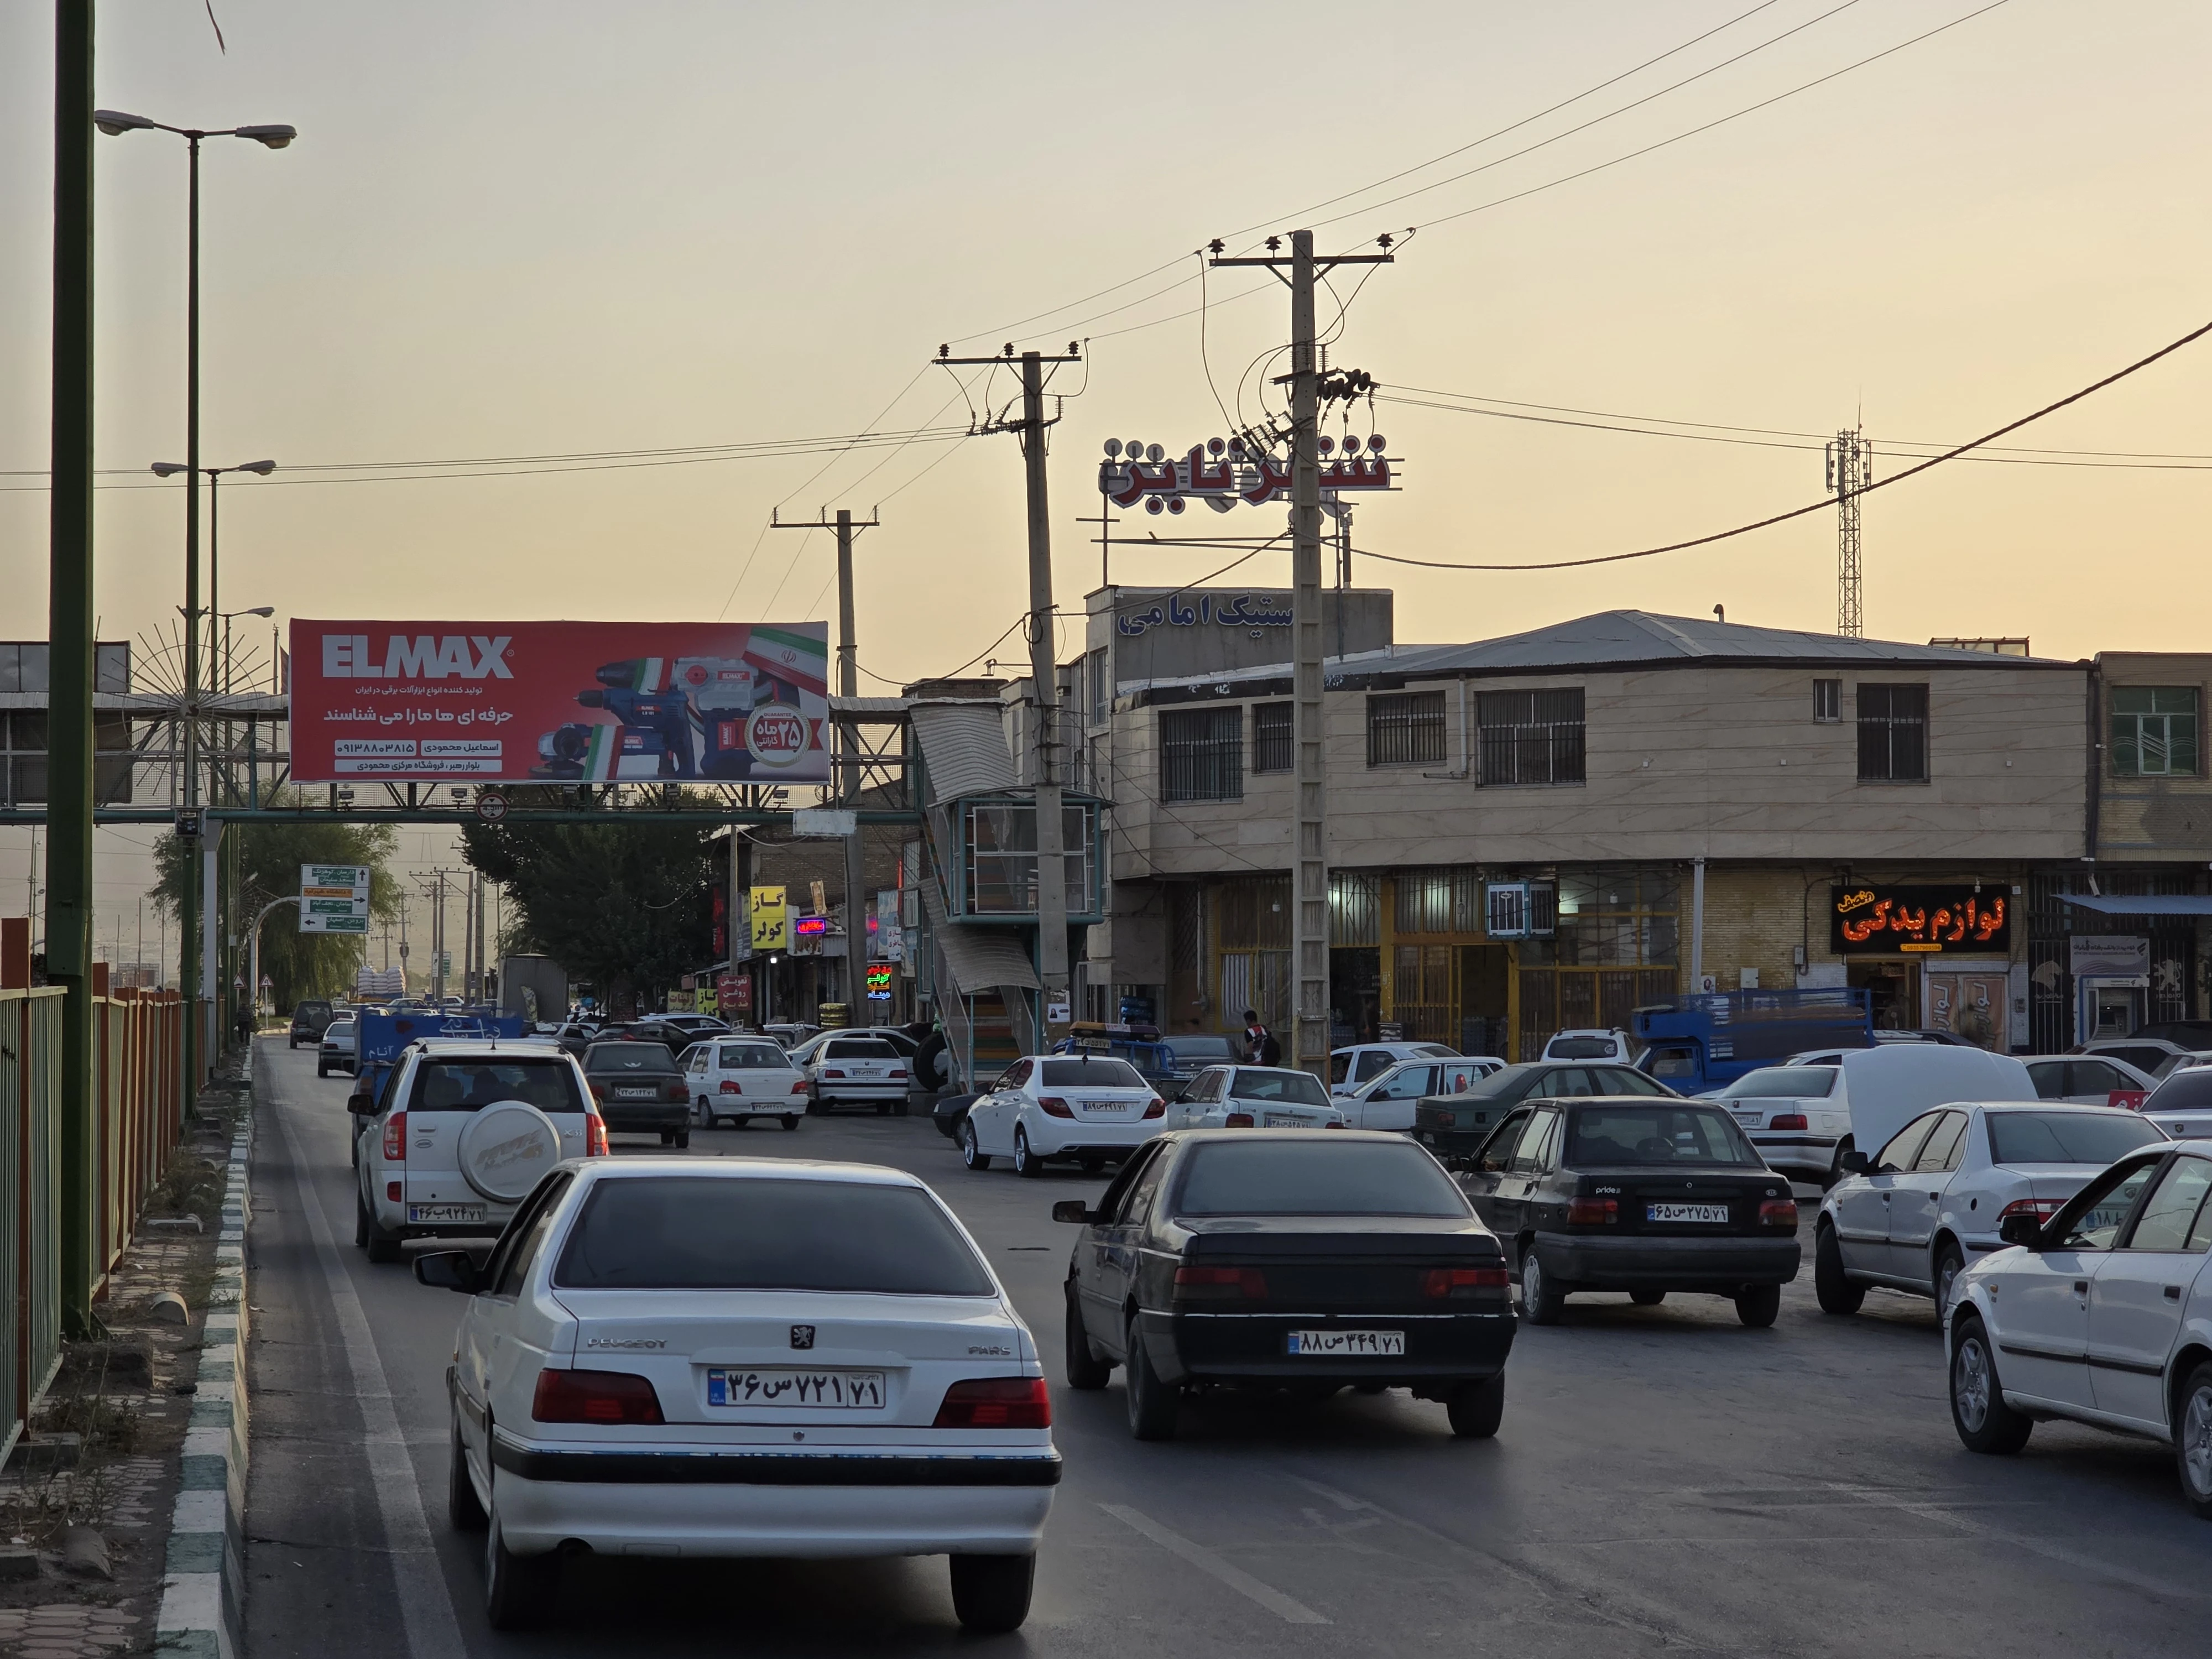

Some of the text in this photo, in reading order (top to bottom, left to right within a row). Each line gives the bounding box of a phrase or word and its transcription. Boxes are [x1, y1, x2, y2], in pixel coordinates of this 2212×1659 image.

[1240, 435, 1390, 507] شر
[1117, 593, 1294, 638] ستیک امامی
[322, 635, 514, 679] ELMAX
[356, 686, 372, 695] ایران
[382, 685, 398, 695] برقی
[426, 686, 442, 697] انواع
[466, 687, 483, 696] تولید
[324, 706, 513, 726] حرفه ای ها ما را می شناسند
[757, 721, 801, 747] ۲۵ ماه
[756, 737, 778, 747] گارانتی
[424, 744, 499, 753] اسماعیل محمودی
[357, 762, 390, 771] محمودی
[391, 761, 413, 771] مرکزی
[414, 760, 445, 770] فروشگاه
[753, 892, 784, 912] گاز
[1841, 896, 2005, 942] لوازم یدکی
[754, 921, 784, 942] کولر
[720, 977, 748, 987] تعویض
[723, 988, 747, 998] روغن
[701, 1006, 718, 1016] کول
[1595, 1186, 1615, 1194] pride
[587, 1338, 668, 1349] PEUGEOT
[968, 1345, 1011, 1355] PARS
